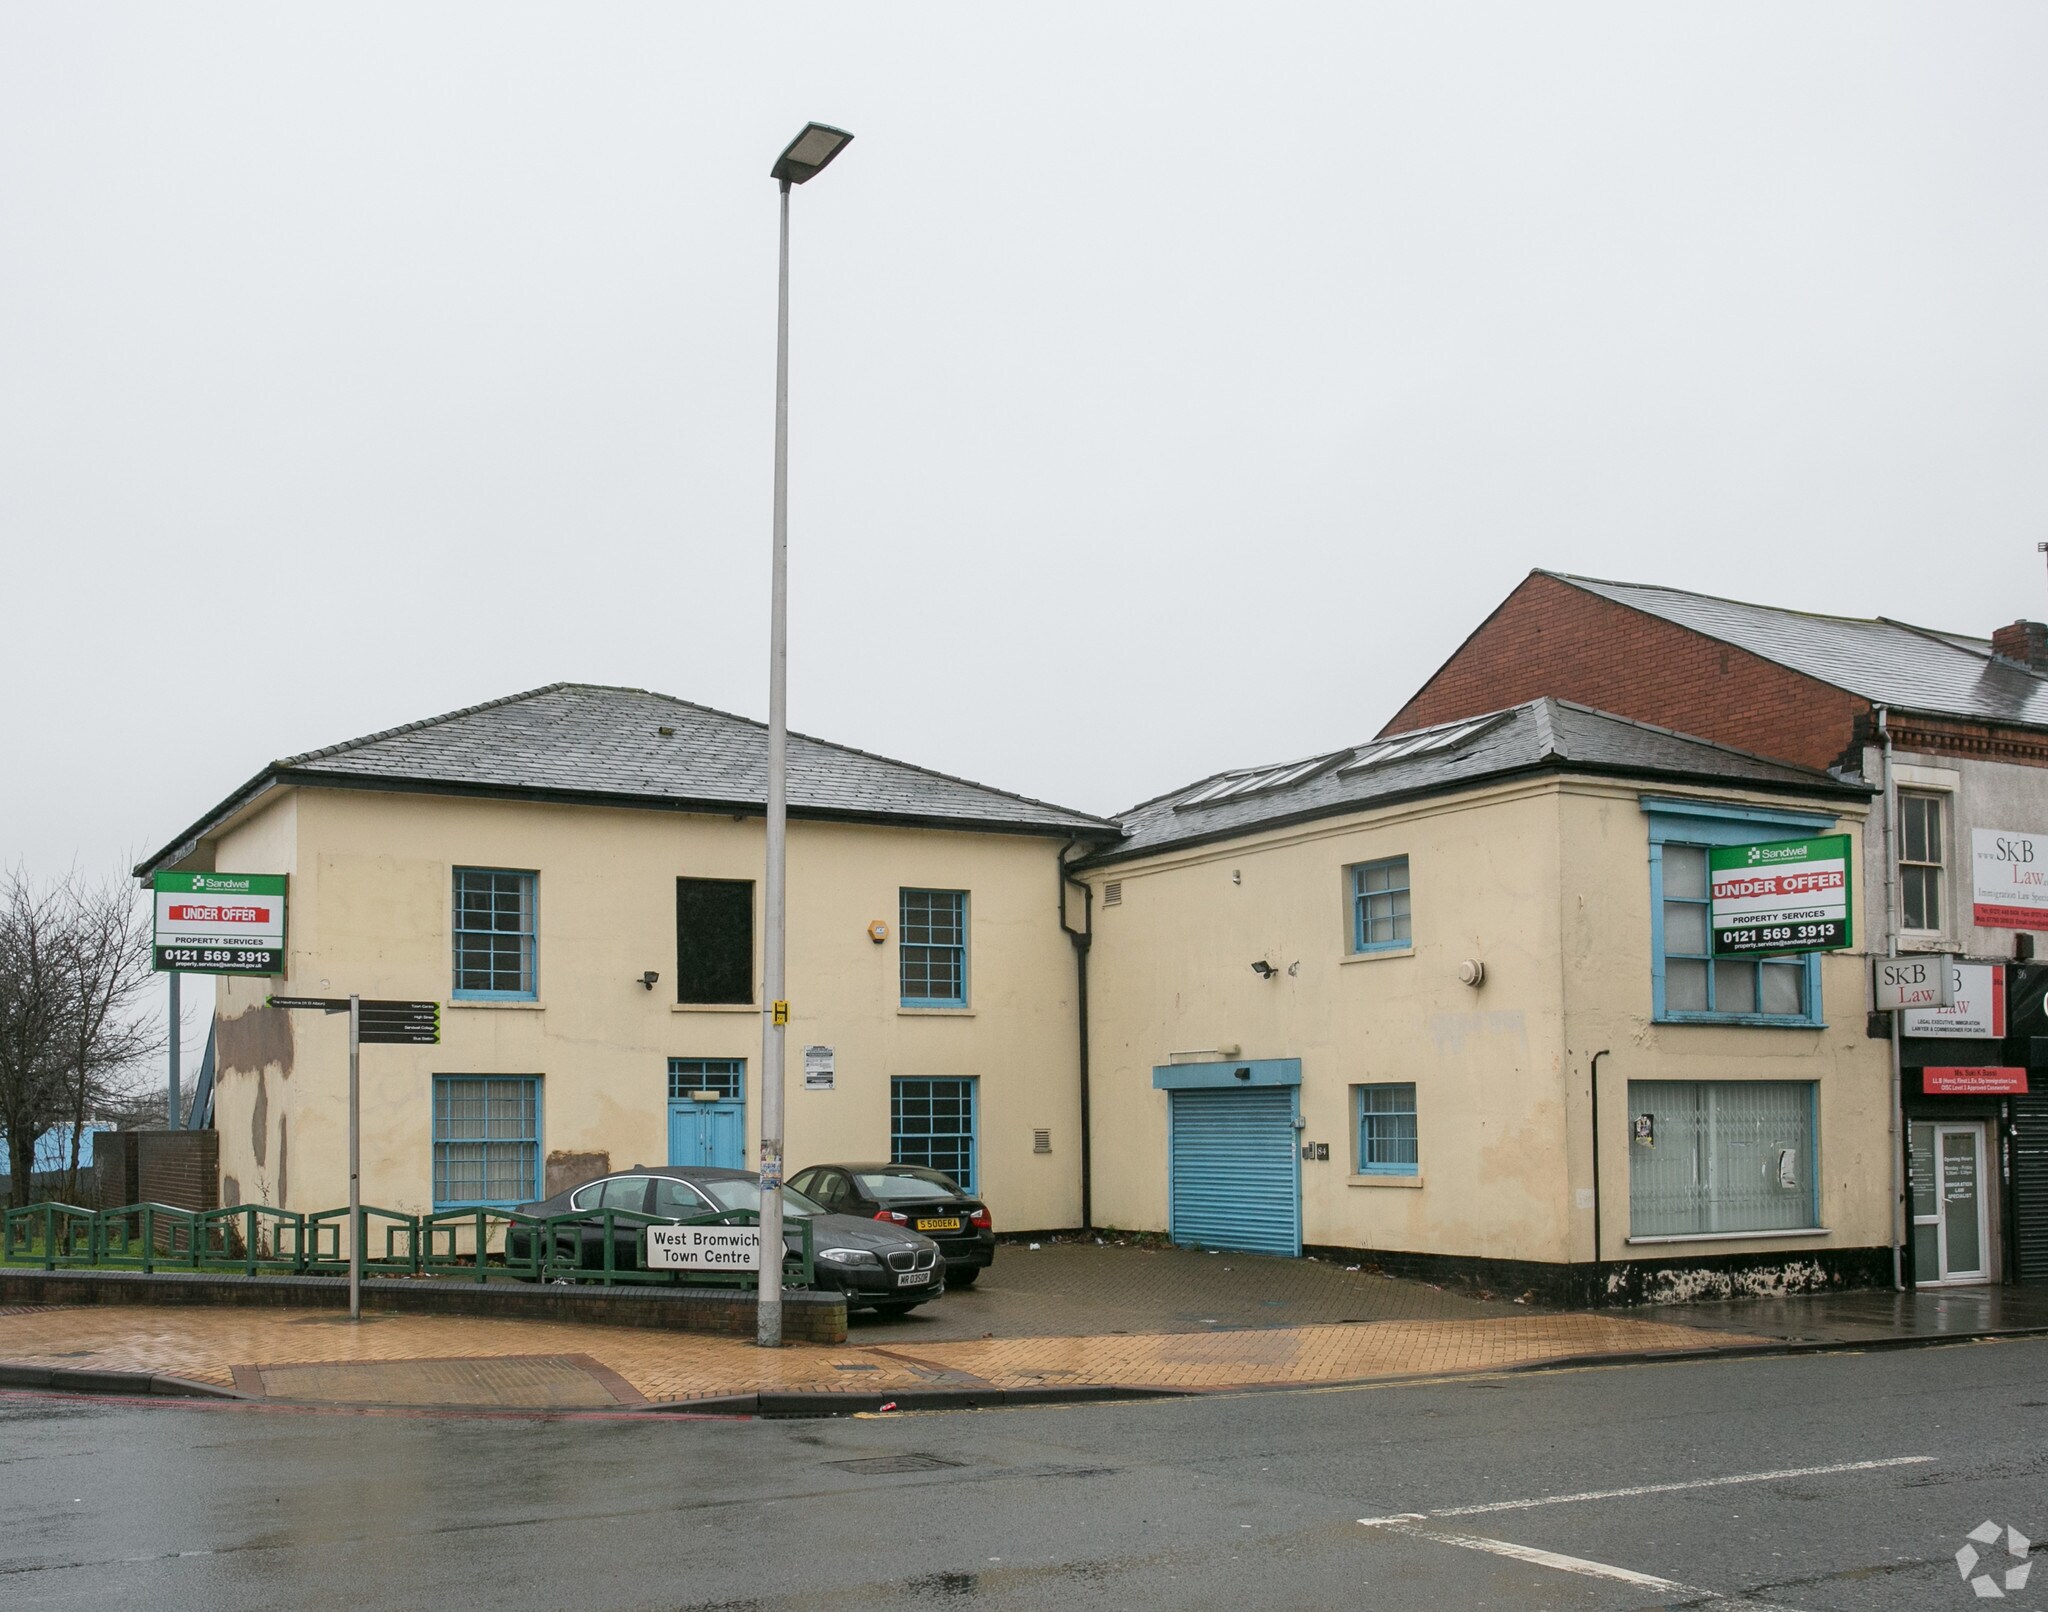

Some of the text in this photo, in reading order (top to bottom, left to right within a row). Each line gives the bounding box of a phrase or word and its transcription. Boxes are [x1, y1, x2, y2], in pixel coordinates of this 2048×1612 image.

[1762, 845, 1808, 859] Sandwell
[206, 879, 249, 888] Sandwell
[1714, 873, 1842, 897] UNDER OFFER
[1979, 888, 2016, 900] Immigration
[2018, 891, 2029, 900] Law
[183, 907, 256, 921] UNDER OFFER
[1733, 910, 1825, 923] PROPERTY SERVICES
[1723, 923, 1835, 943] 0121 569 3913
[223, 938, 264, 946] SERVICES
[1734, 937, 1825, 950] property.services@sandwell.gov.uk
[165, 949, 270, 962] 0121 569 3913
[1884, 964, 1926, 986] SKB
[1899, 986, 1935, 1004] Law
[775, 1003, 787, 1022] H
[1317, 1146, 1327, 1156] 84
[654, 1232, 759, 1246] West Bromwich
[663, 1249, 751, 1263] Town Centre
